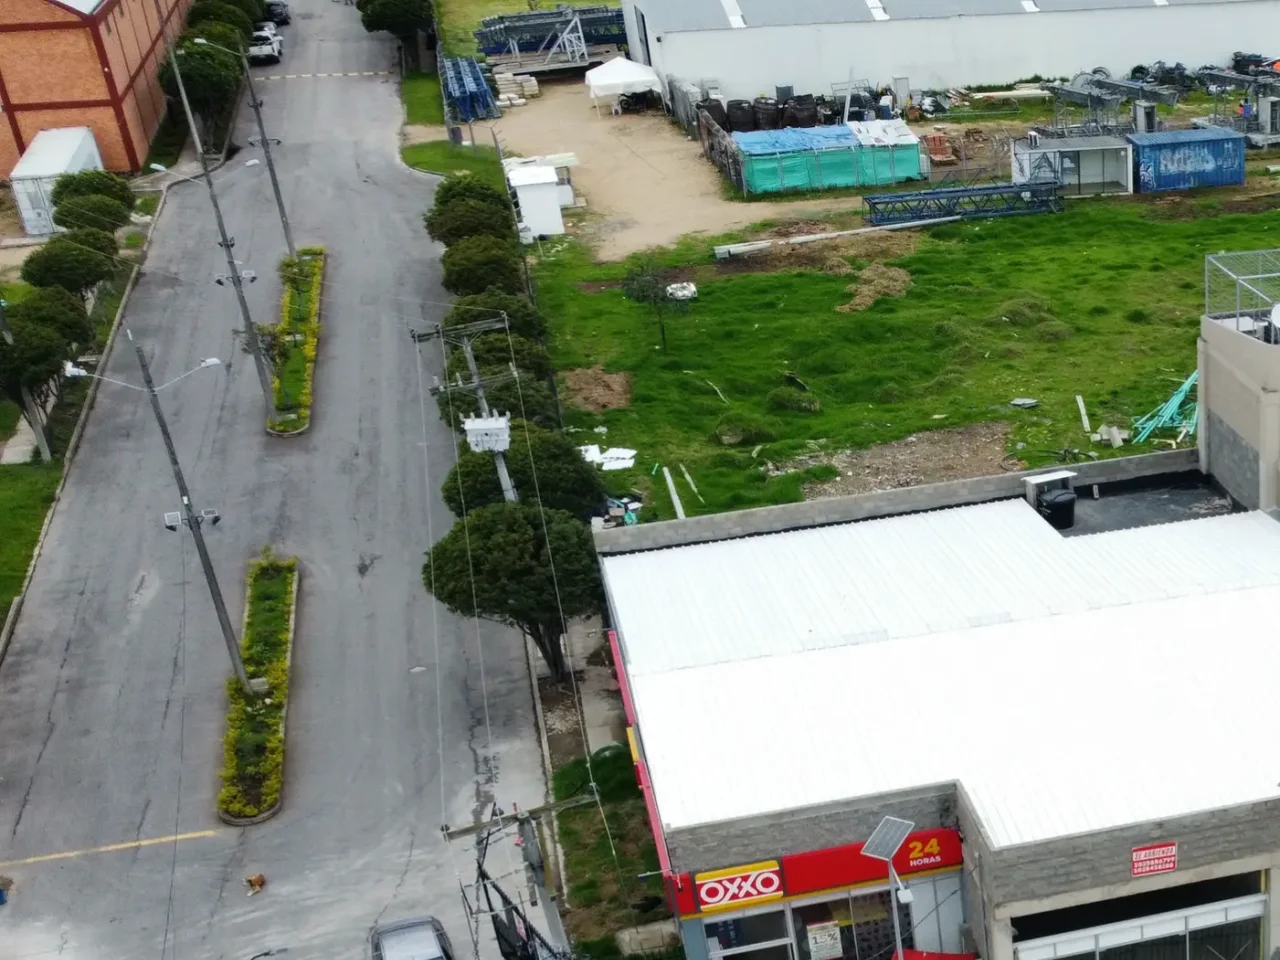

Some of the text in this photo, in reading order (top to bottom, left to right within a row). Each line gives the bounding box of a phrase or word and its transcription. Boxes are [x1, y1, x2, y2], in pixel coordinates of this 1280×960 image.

[908, 838, 941, 859] 24
[910, 855, 941, 867] HORAS
[700, 871, 780, 904] OXXO
[811, 932, 838, 945] 15%
